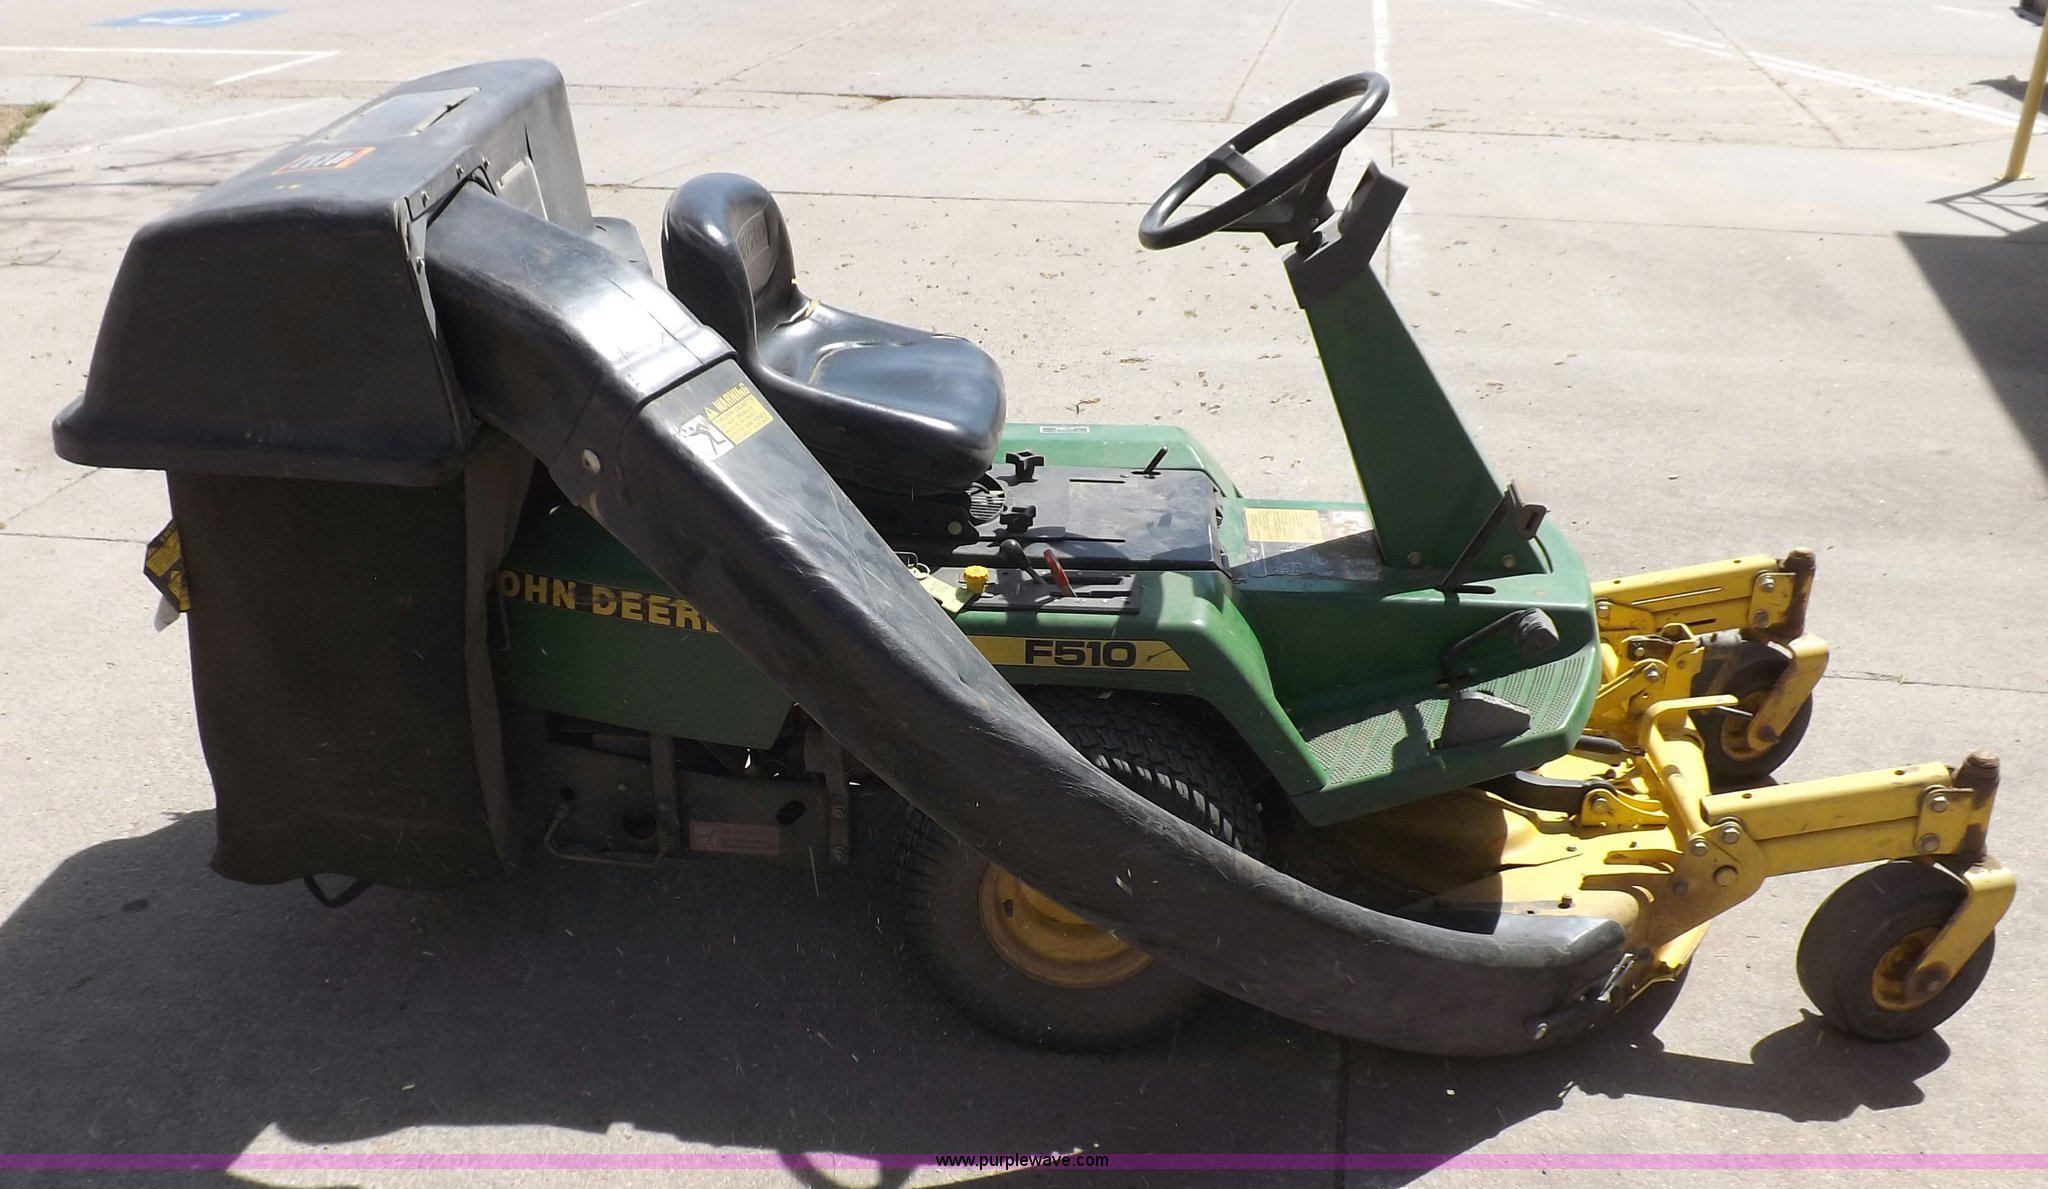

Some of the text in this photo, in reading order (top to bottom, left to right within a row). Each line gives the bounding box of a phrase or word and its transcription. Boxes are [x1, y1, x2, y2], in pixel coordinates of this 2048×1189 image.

[711, 382, 751, 412] WARNING
[497, 570, 576, 610] OHN
[1025, 639, 1136, 667] F510
